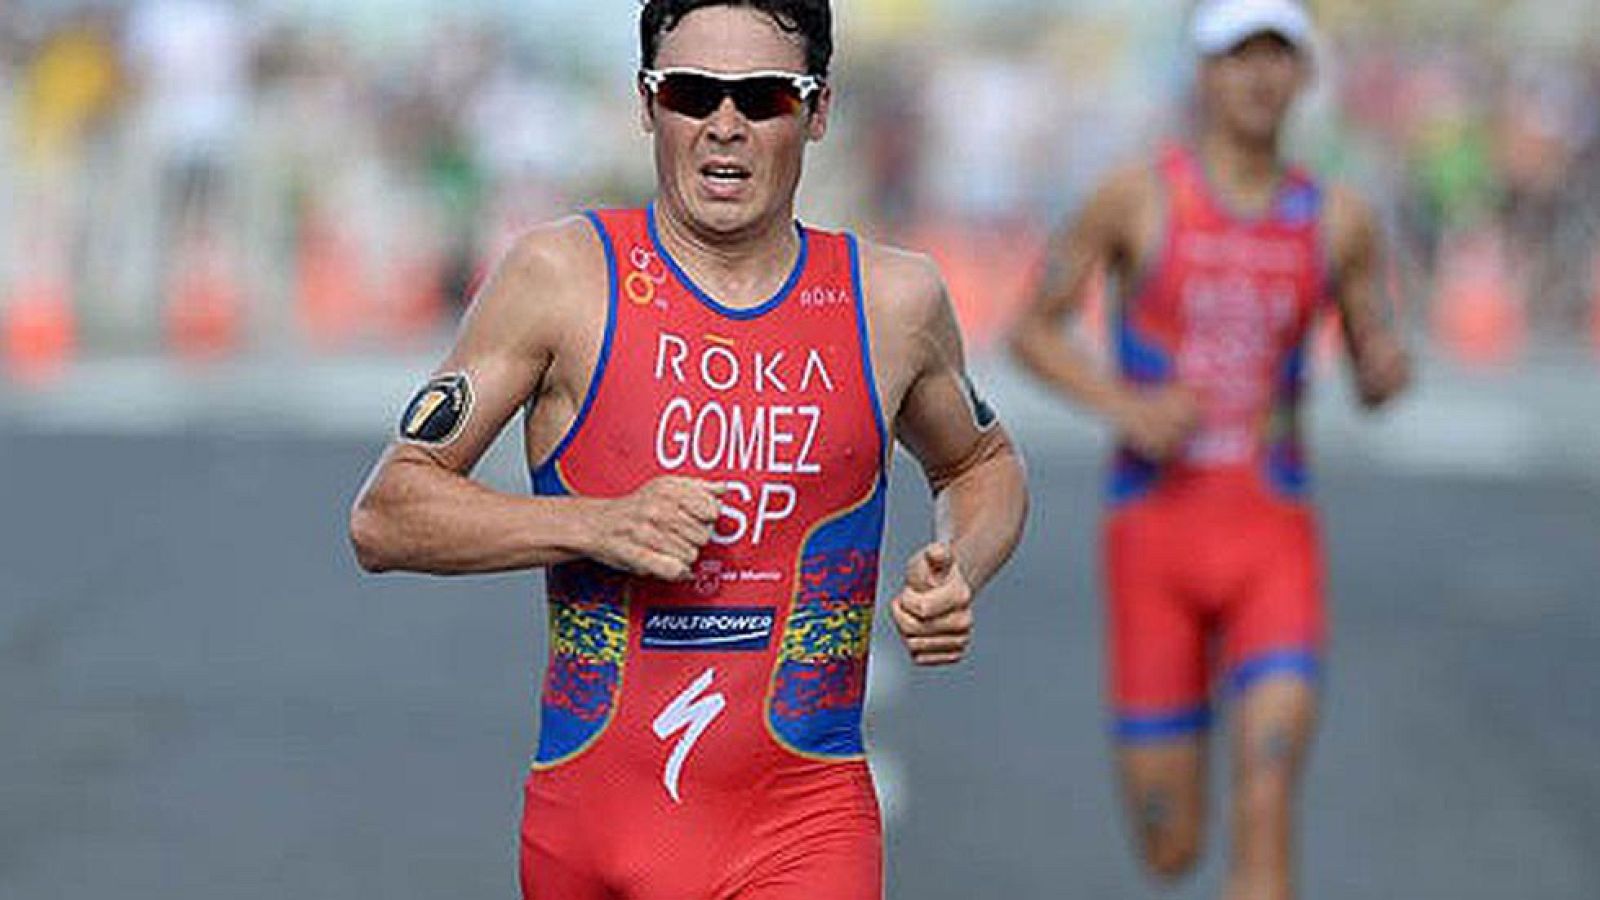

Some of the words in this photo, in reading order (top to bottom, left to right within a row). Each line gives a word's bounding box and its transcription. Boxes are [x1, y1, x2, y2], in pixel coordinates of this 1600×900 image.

[656, 396, 821, 473] GOMEZ
[709, 480, 797, 545] SP
[646, 615, 772, 630] MULTIPOWER
